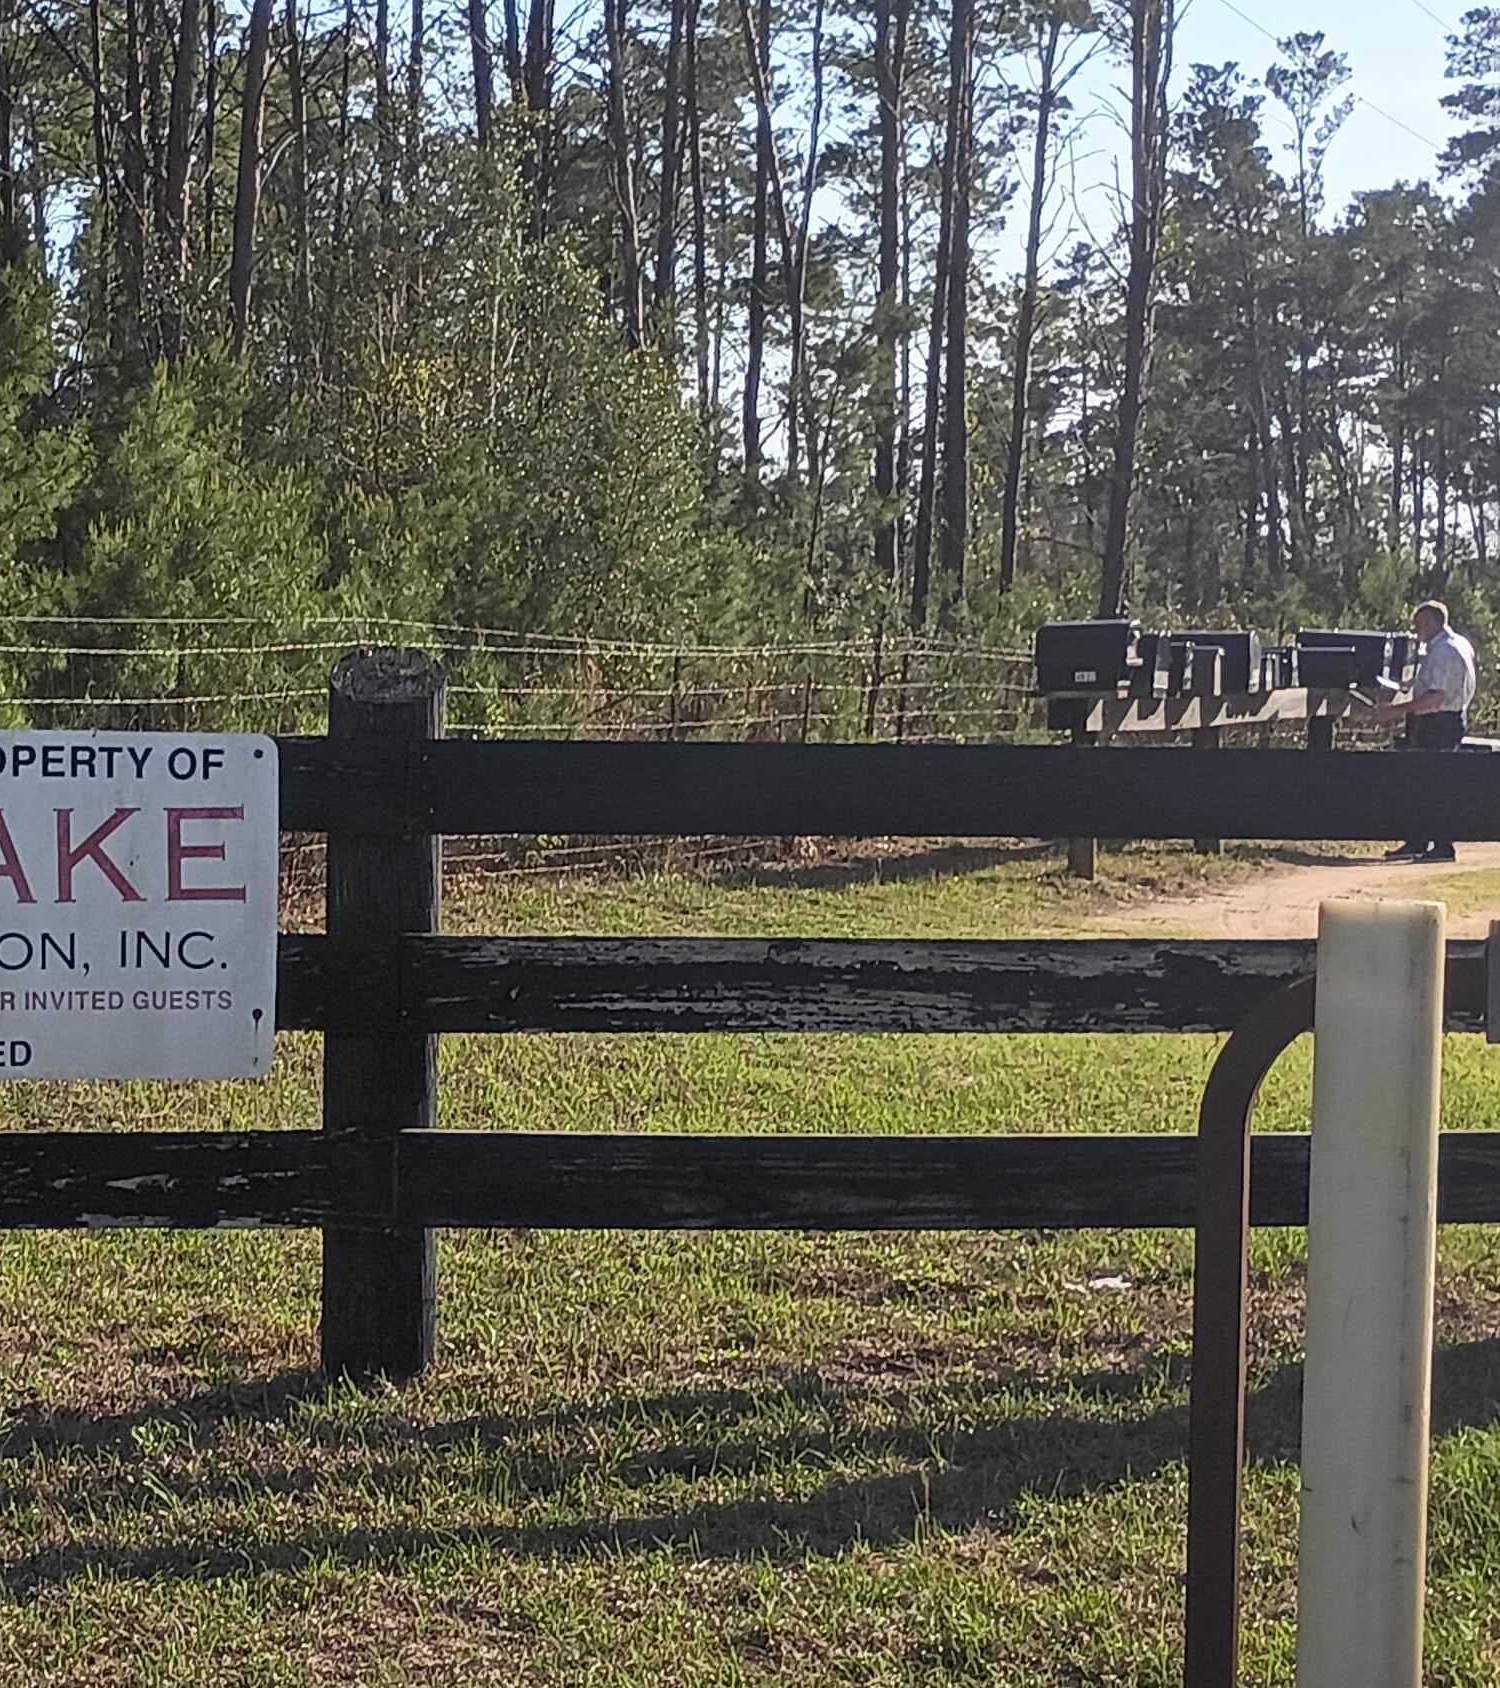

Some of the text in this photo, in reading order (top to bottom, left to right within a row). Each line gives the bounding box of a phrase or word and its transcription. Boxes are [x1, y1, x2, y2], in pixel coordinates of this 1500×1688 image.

[168, 747, 225, 780] OF
[120, 930, 228, 970] INC.
[25, 991, 124, 1011] INVITED
[133, 990, 232, 1010] GUESTS
